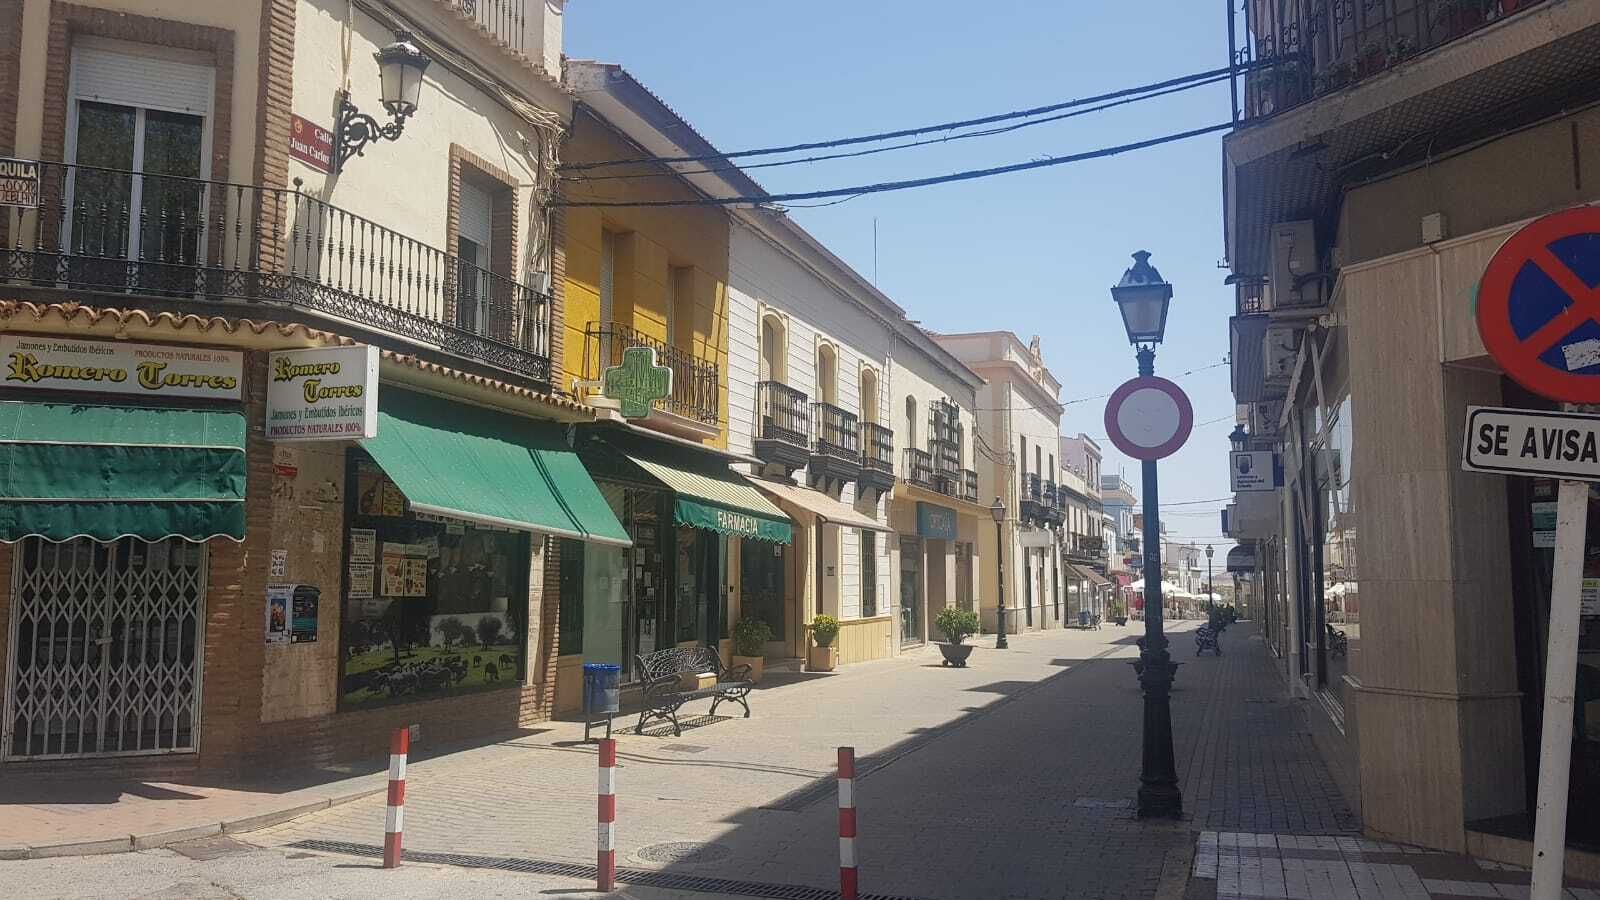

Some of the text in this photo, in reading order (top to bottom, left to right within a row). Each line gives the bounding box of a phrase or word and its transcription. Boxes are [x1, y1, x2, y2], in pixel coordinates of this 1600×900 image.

[314, 128, 332, 145] Calle
[291, 137, 329, 164] Juan Carlos
[0, 162, 37, 178] QUILA
[16, 339, 46, 352] Jamones
[53, 343, 87, 354] Embutidos
[135, 349, 174, 360] PRODUCTOS
[175, 352, 212, 362] NATURALES
[6, 352, 237, 390] Romero Torres
[274, 357, 340, 382] Romero
[303, 379, 363, 403] Torres
[271, 422, 361, 435] PRODUCTOS NATURALES 100%
[1477, 423, 1598, 463] SE AVISA
[717, 511, 758, 534] FARMACIA
